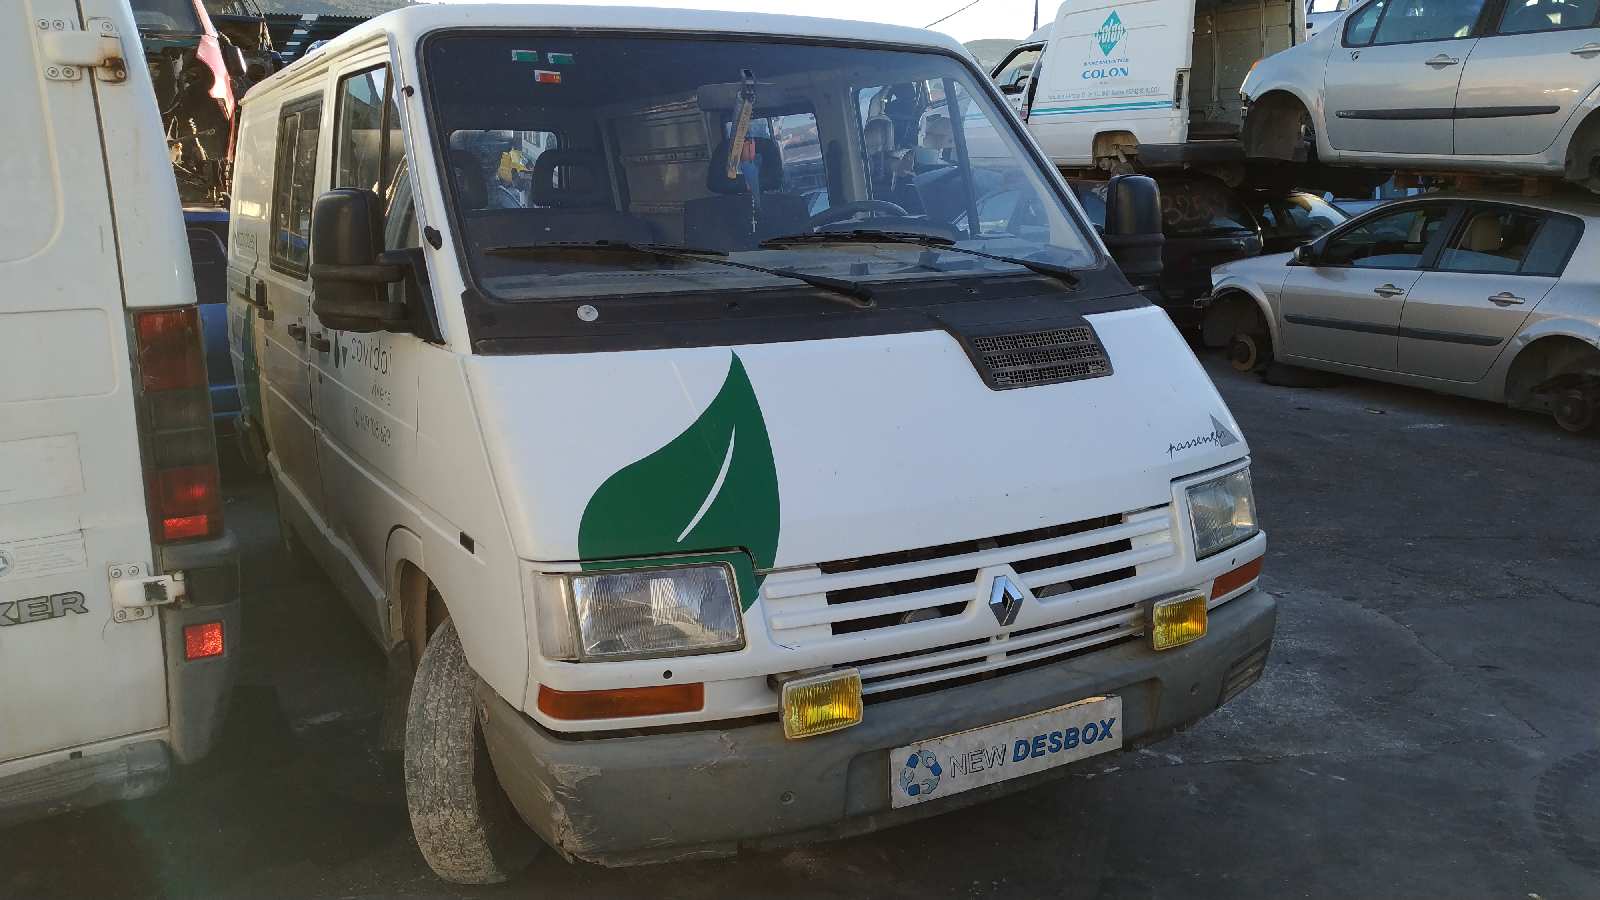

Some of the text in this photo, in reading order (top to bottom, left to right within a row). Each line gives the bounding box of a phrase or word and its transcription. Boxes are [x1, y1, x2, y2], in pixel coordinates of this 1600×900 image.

[1081, 66, 1129, 80] COLON
[949, 717, 1116, 779] NEW DESBOX
